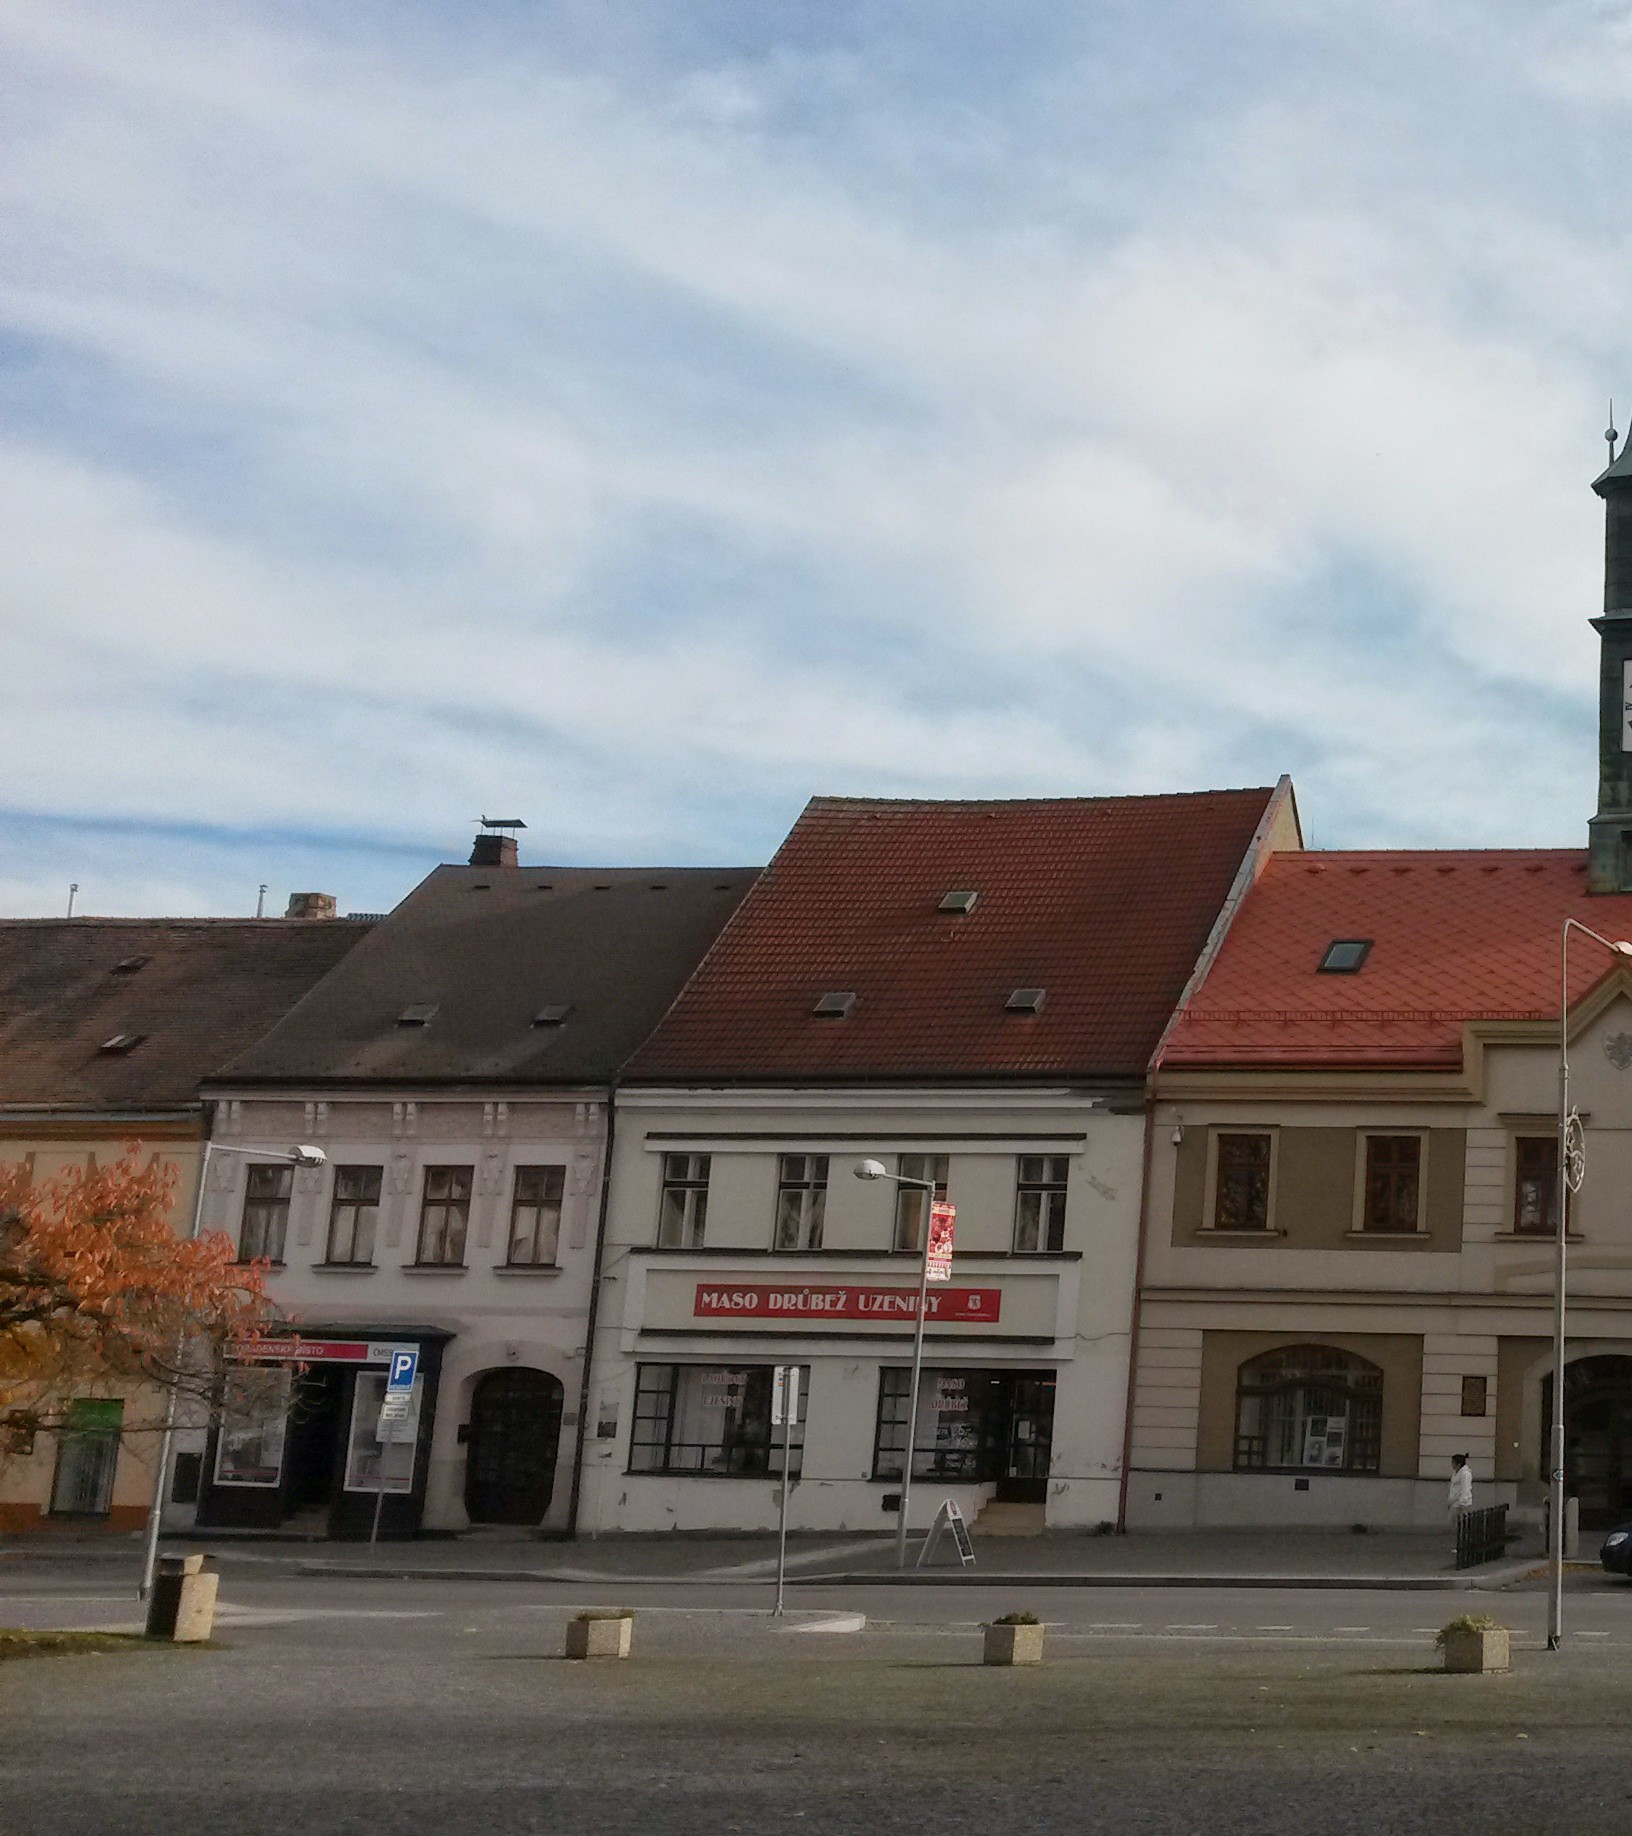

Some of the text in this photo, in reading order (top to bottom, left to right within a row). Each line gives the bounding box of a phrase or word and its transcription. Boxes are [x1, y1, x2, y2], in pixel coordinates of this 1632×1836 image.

[701, 1292, 759, 1309] MASO
[768, 1288, 847, 1311] DRŮBEŽ
[394, 1355, 412, 1380] P
